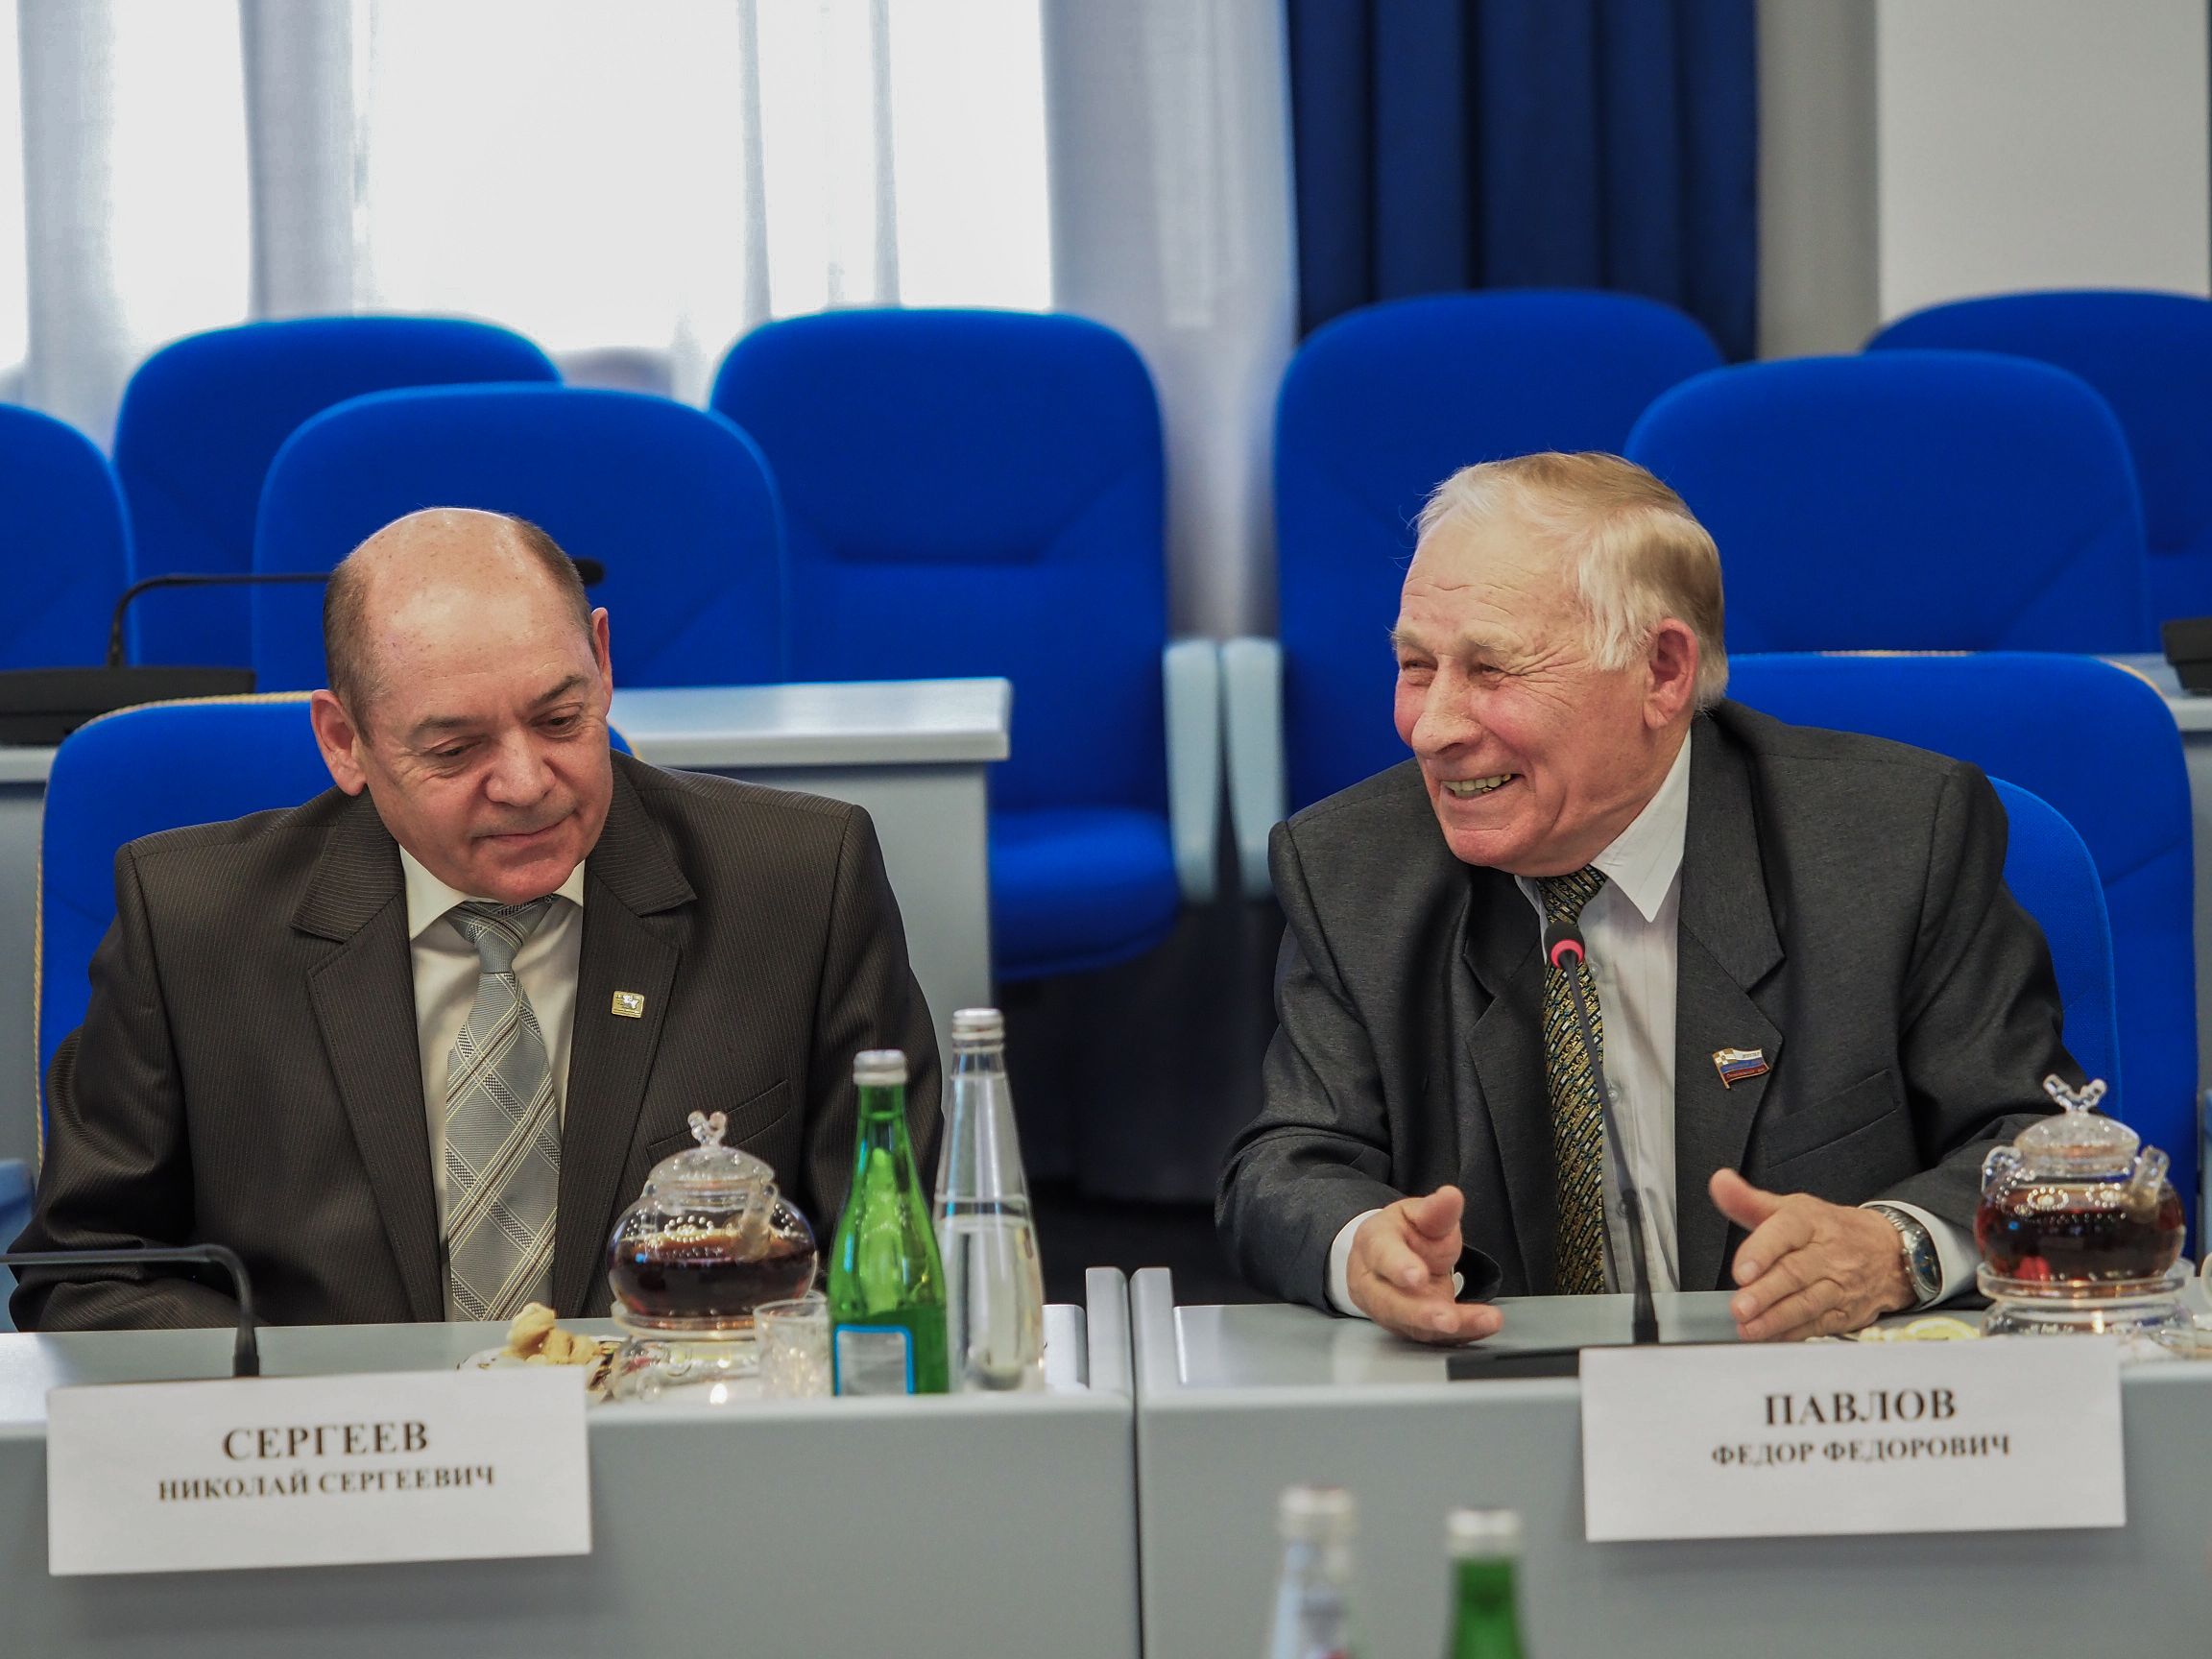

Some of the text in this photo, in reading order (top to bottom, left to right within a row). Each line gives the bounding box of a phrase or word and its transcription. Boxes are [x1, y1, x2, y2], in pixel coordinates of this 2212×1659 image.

[1764, 1387, 1957, 1427] ПАВЛОВ
[221, 1421, 428, 1461] СЕРГЕЕВ
[1711, 1433, 2011, 1466] ФЕДОР ФЕДОРОВИЧ
[157, 1465, 495, 1502] НИКОЛАЙ СЕРГЕЕВИЧ
